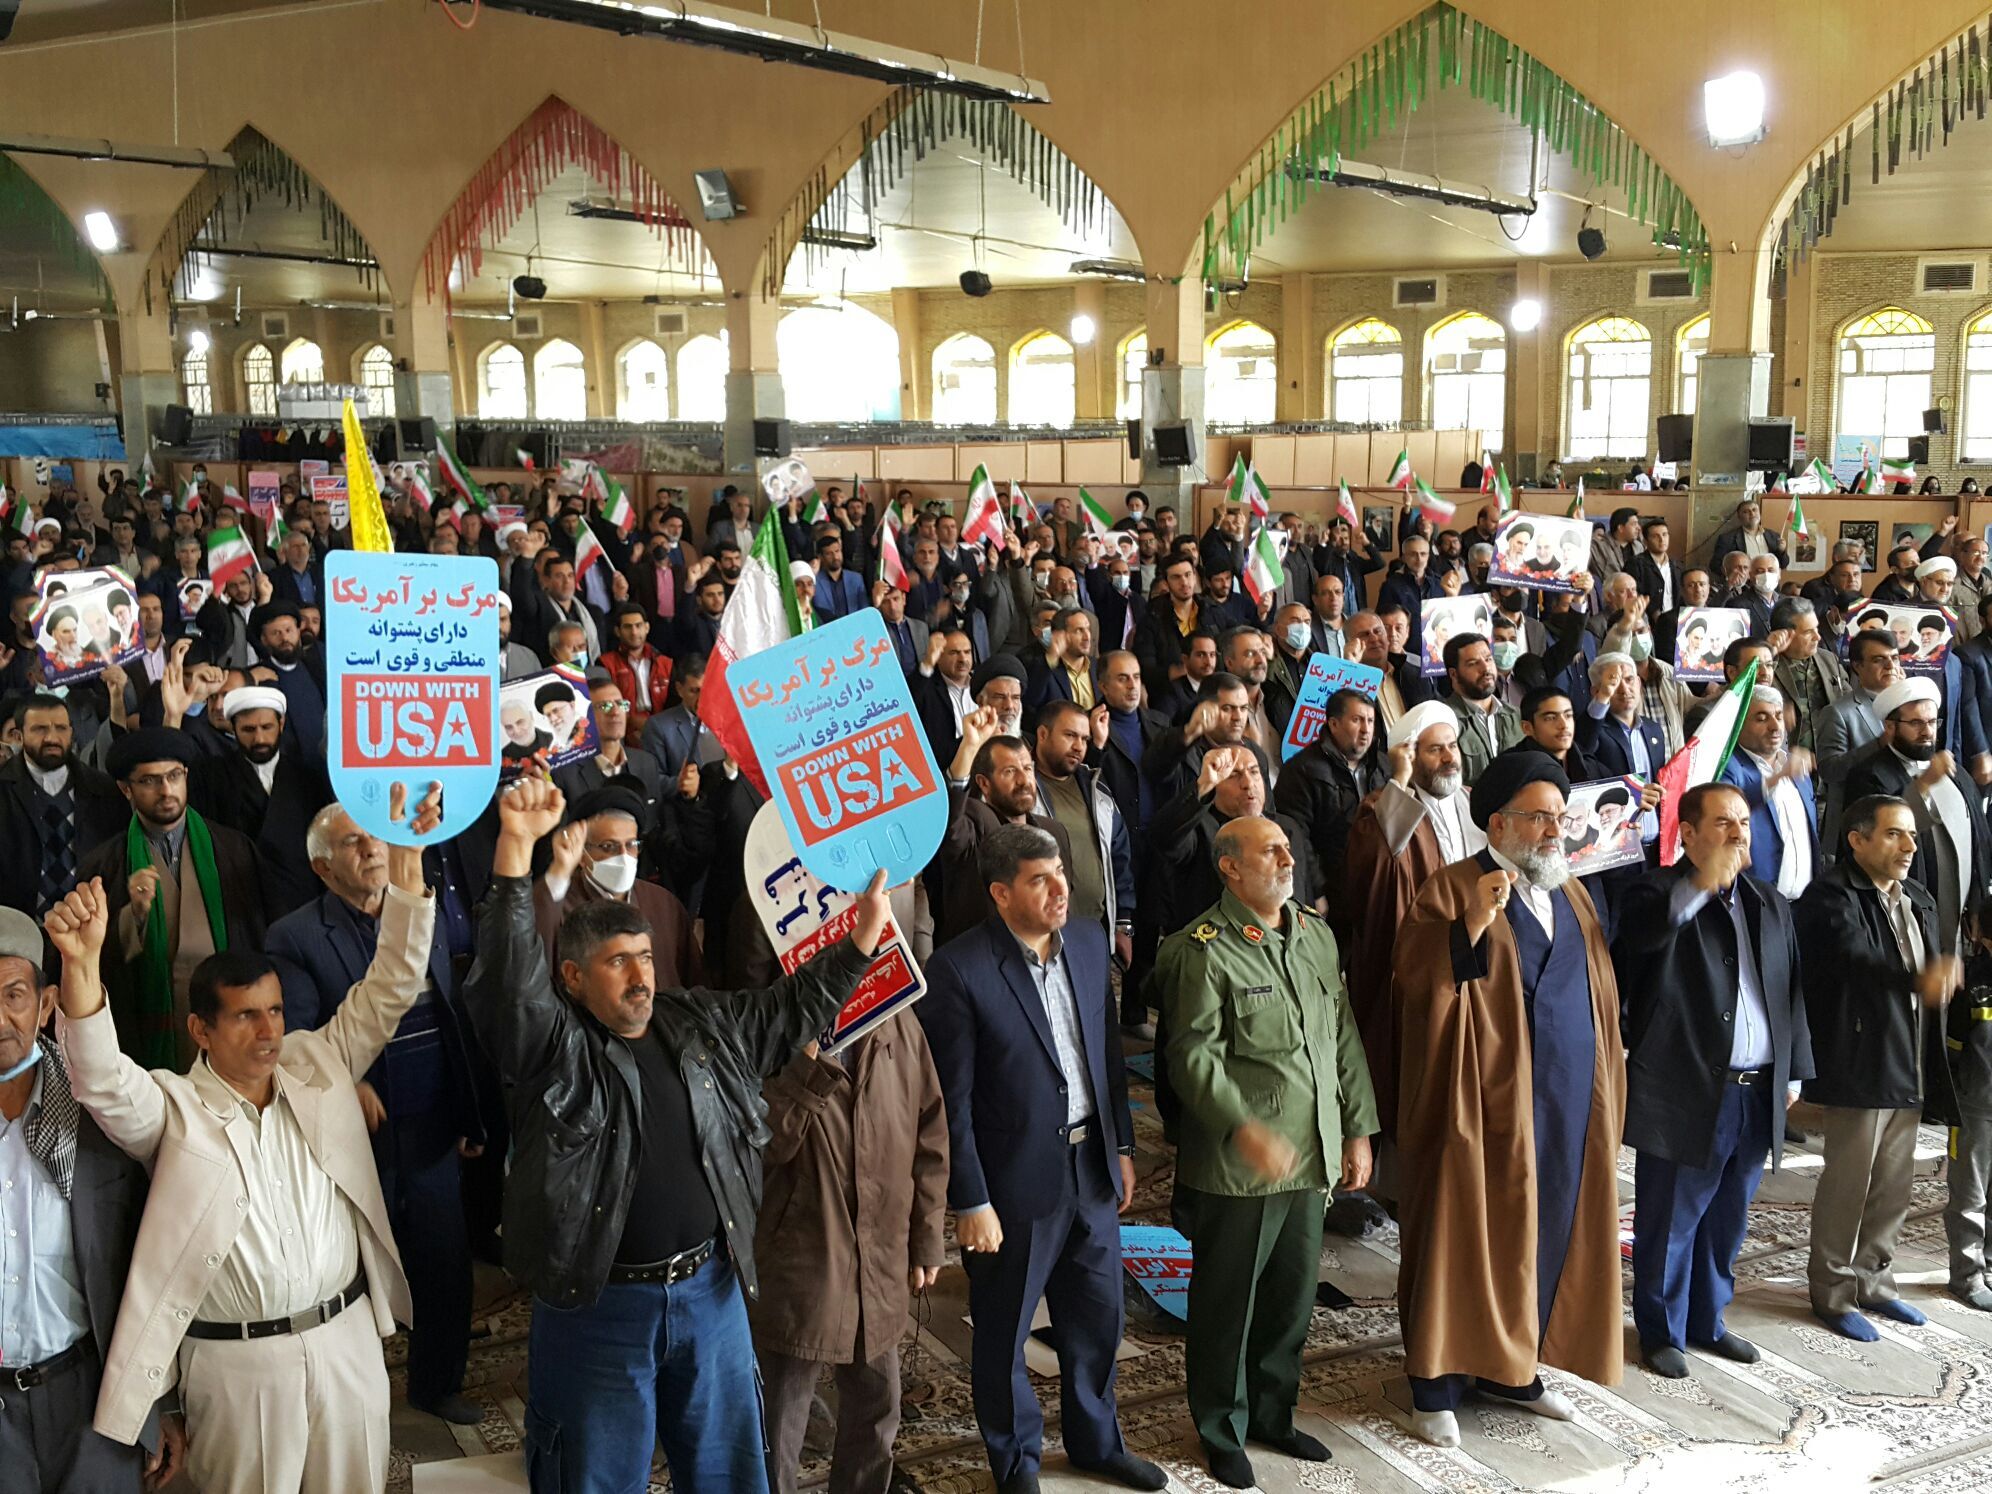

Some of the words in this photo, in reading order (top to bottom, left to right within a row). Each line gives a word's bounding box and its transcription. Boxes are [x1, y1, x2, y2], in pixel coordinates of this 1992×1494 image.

[332, 575, 414, 613] آمریکا
[415, 588, 438, 615] بر
[446, 581, 497, 616] مرگ
[368, 618, 423, 644] پشتوانه
[424, 621, 468, 644] دارای
[346, 649, 380, 666] است
[387, 648, 419, 671] قوی
[422, 657, 431, 672] و
[434, 650, 485, 672] منطقی
[842, 636, 891, 668] مرگ
[737, 655, 811, 709] آمریکا
[819, 657, 838, 688] بر
[1309, 663, 1345, 682] آمریکا
[1341, 677, 1353, 688] بر
[1355, 679, 1378, 693] مرگ
[355, 681, 420, 698] DOWN
[425, 682, 480, 698] WITH
[834, 676, 874, 708] دارای
[785, 693, 836, 725] پشتوانه
[853, 698, 900, 729] منطقی
[356, 700, 479, 759] USA
[811, 716, 839, 747] قوی
[843, 719, 851, 735] و
[774, 731, 806, 758] است
[791, 746, 851, 783] DOWN
[852, 723, 904, 755] WITH
[797, 746, 923, 830] USA
[776, 884, 847, 936] مرگ
[785, 949, 798, 975] از
[798, 944, 816, 965] فتنه
[829, 911, 850, 941] بیزار
[858, 953, 900, 990] ماندگار
[843, 988, 877, 1014] حماسه
